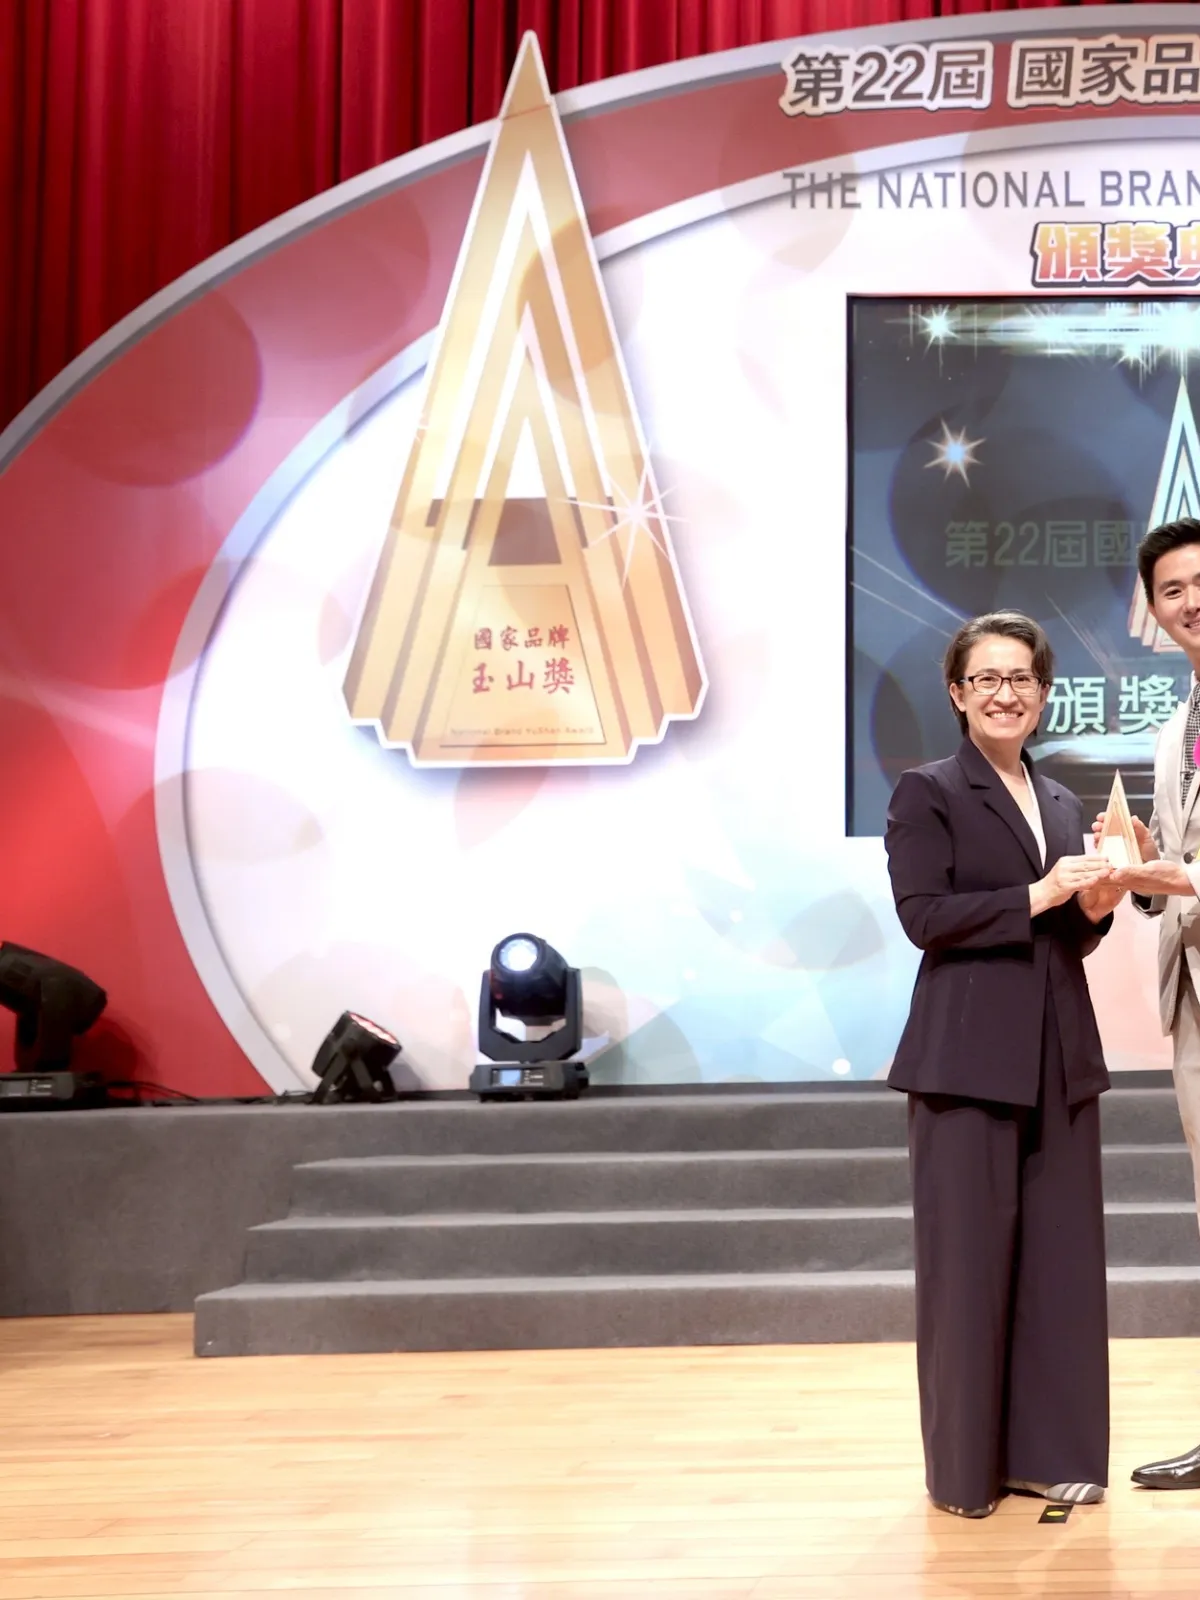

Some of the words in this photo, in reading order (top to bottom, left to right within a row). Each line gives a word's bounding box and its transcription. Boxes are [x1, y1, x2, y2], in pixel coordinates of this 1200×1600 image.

[787, 47, 988, 108] 第22屆
[782, 171, 862, 209] THE
[877, 170, 1086, 209] NATIONAL
[473, 623, 571, 651] 國家品牌
[471, 657, 575, 695] 玉山獎
